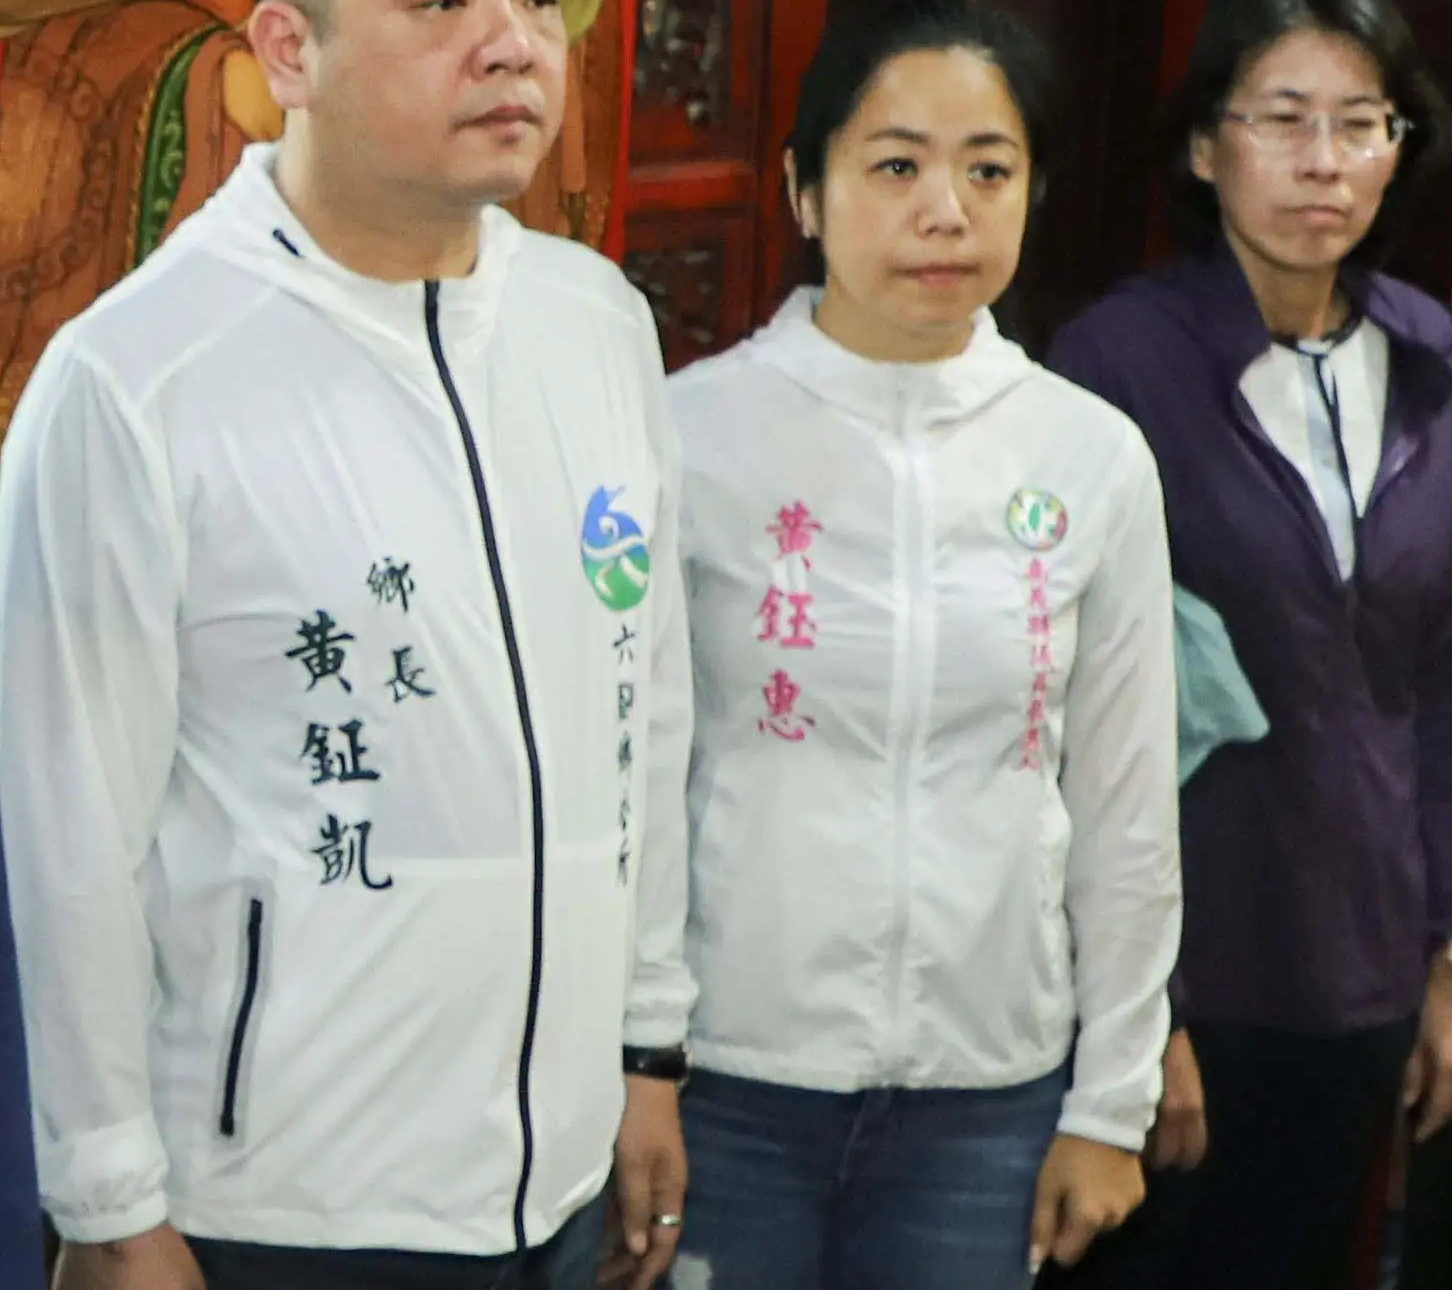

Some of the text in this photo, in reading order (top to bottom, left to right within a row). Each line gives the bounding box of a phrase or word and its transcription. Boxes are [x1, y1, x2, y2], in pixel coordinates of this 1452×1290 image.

[366, 556, 437, 704] 鄉長
[284, 609, 394, 891] 黃鉦凱
